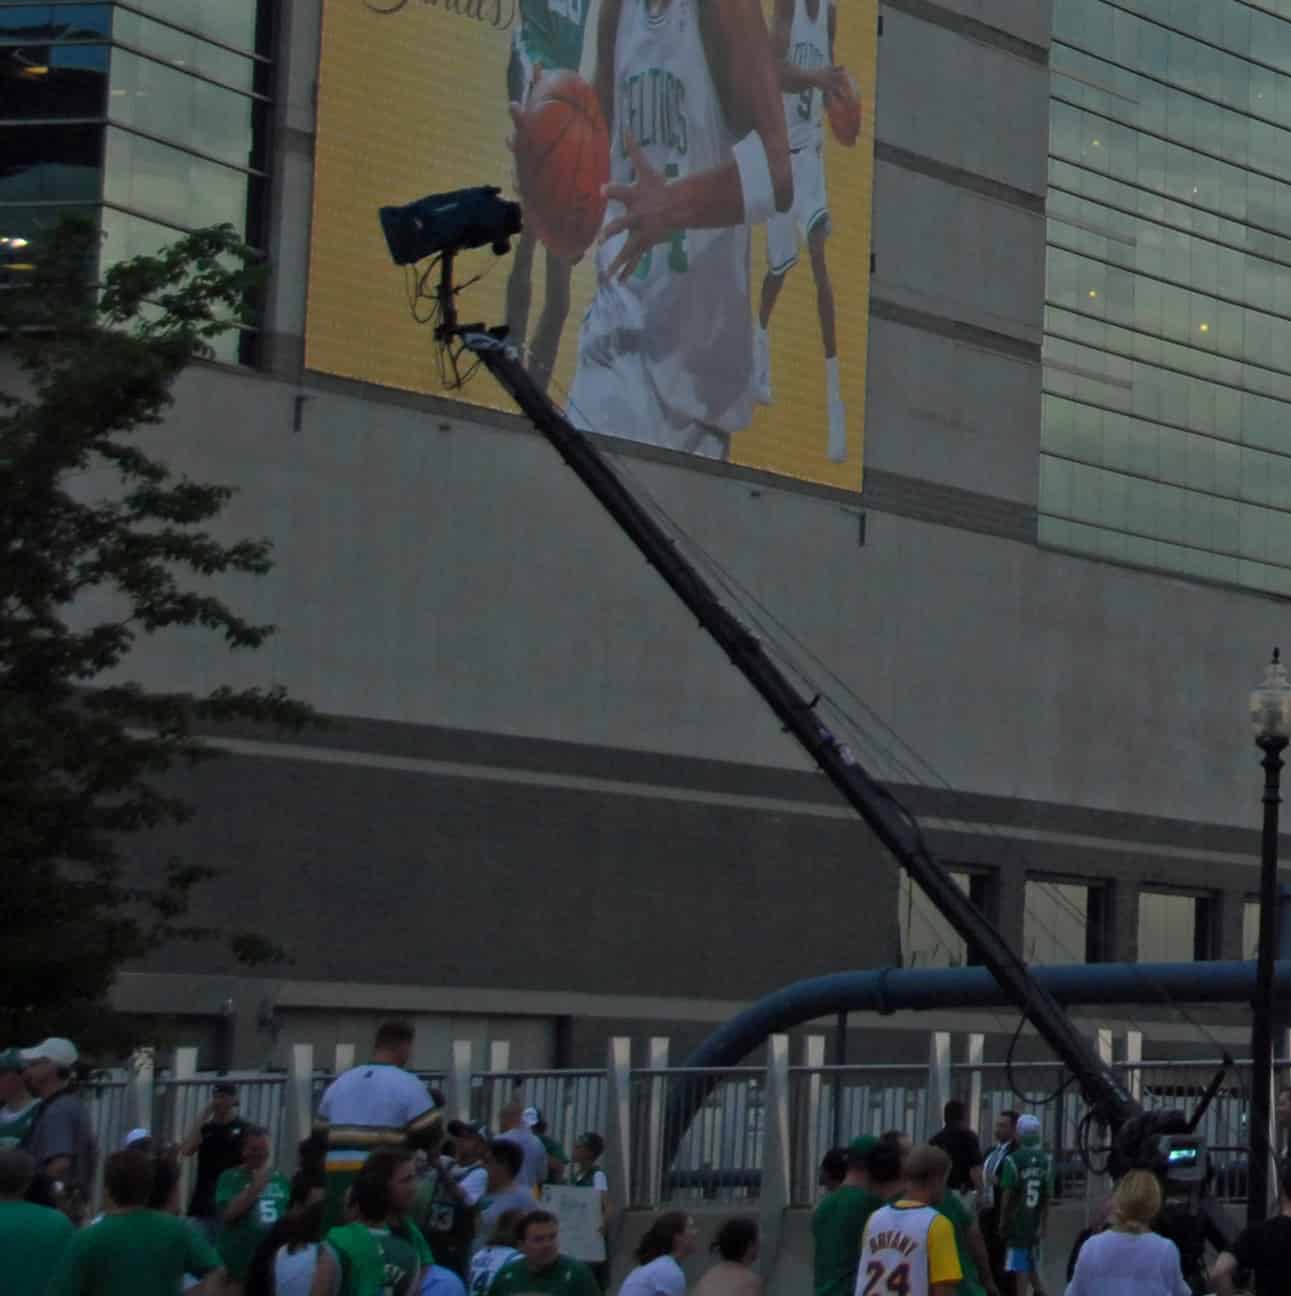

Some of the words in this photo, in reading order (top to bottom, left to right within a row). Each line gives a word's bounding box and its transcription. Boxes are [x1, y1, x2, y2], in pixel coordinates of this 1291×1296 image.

[1025, 1178, 1041, 1209] 5
[258, 1199, 279, 1224] 5
[869, 1230, 918, 1257] BRYANT
[863, 1261, 910, 1296] 24
